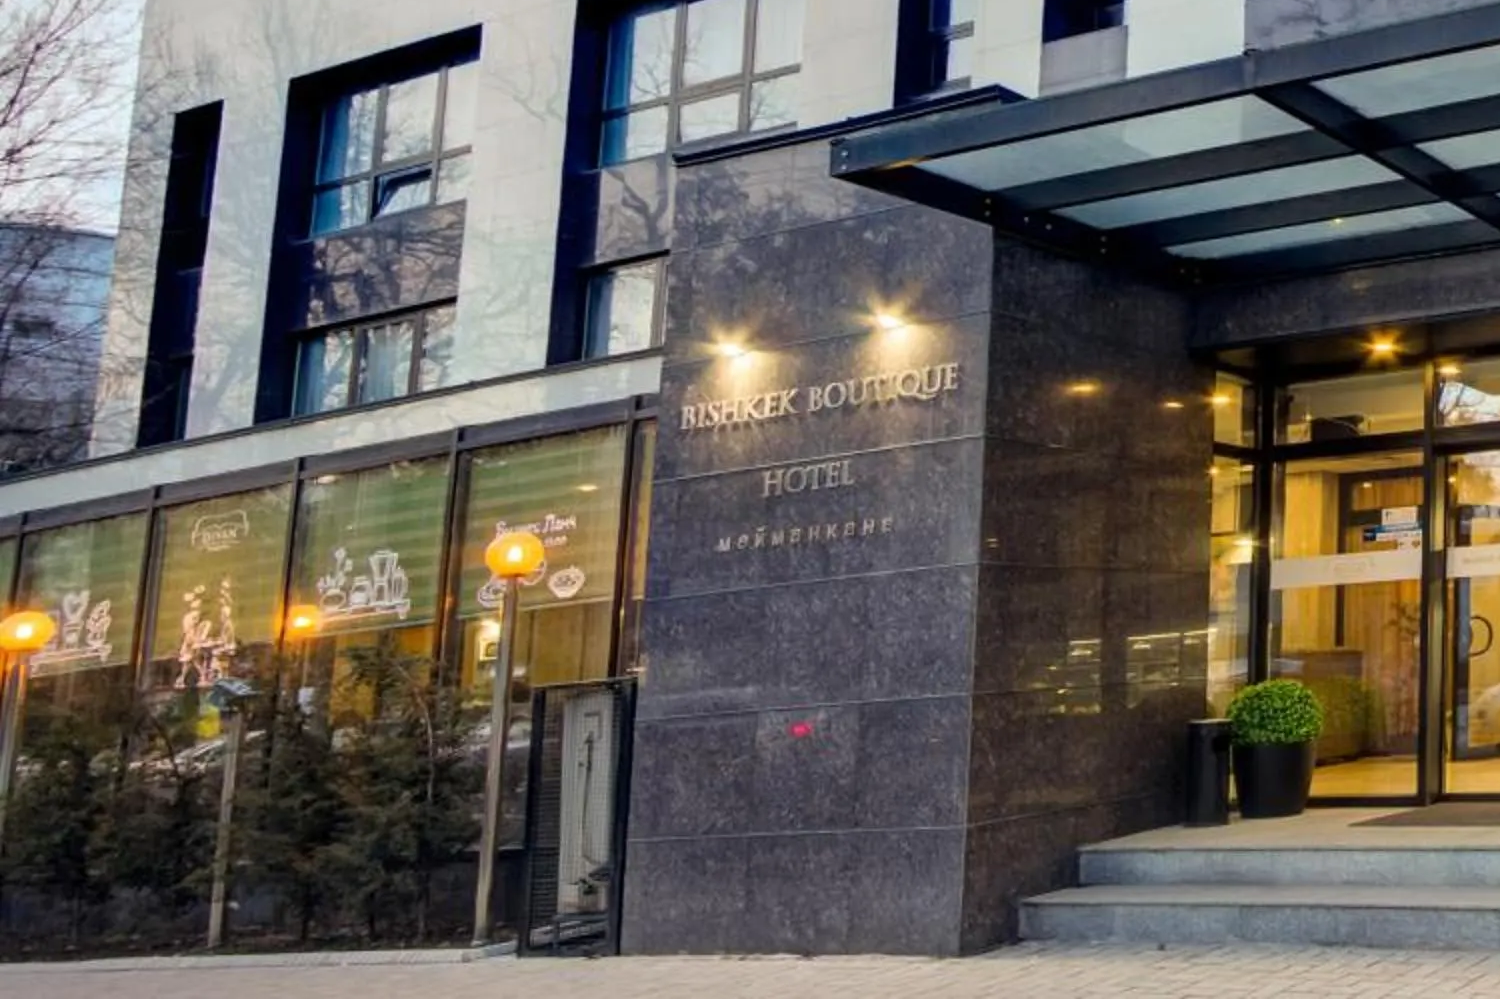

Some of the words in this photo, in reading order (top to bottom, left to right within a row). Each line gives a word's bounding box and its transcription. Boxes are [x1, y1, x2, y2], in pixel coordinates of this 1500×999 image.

[680, 388, 799, 430] BISHKEK
[807, 362, 959, 413] BOUTIQUE
[761, 459, 856, 498] HOTEL
